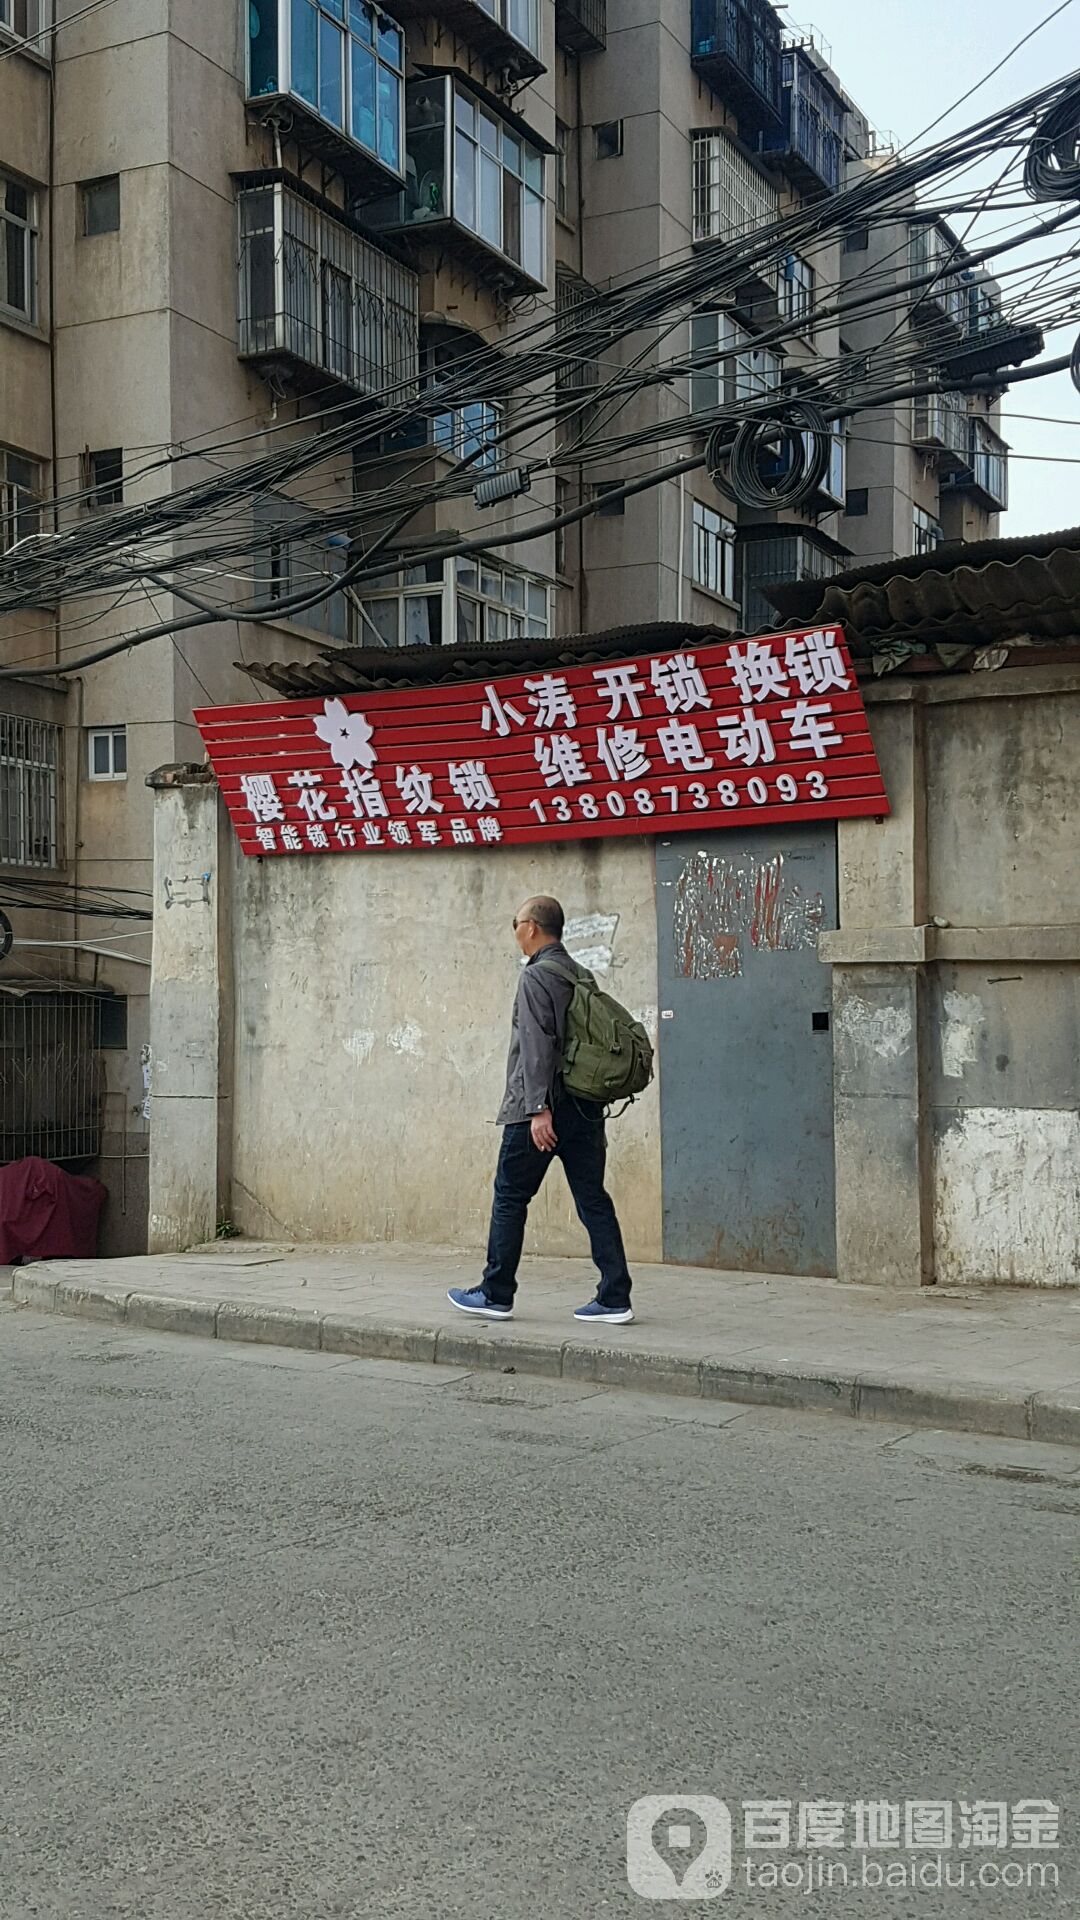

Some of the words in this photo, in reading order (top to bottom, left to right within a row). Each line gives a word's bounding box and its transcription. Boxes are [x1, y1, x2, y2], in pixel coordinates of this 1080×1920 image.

[480, 674, 578, 737] 小涛
[592, 654, 713, 721] 开锁
[726, 630, 852, 703] 换锁
[534, 700, 845, 788] 维修电动车
[240, 760, 500, 823] 樱花指纹锁
[530, 771, 830, 823] 13808738093
[254, 816, 504, 852] 智能锁行业领军品牌
